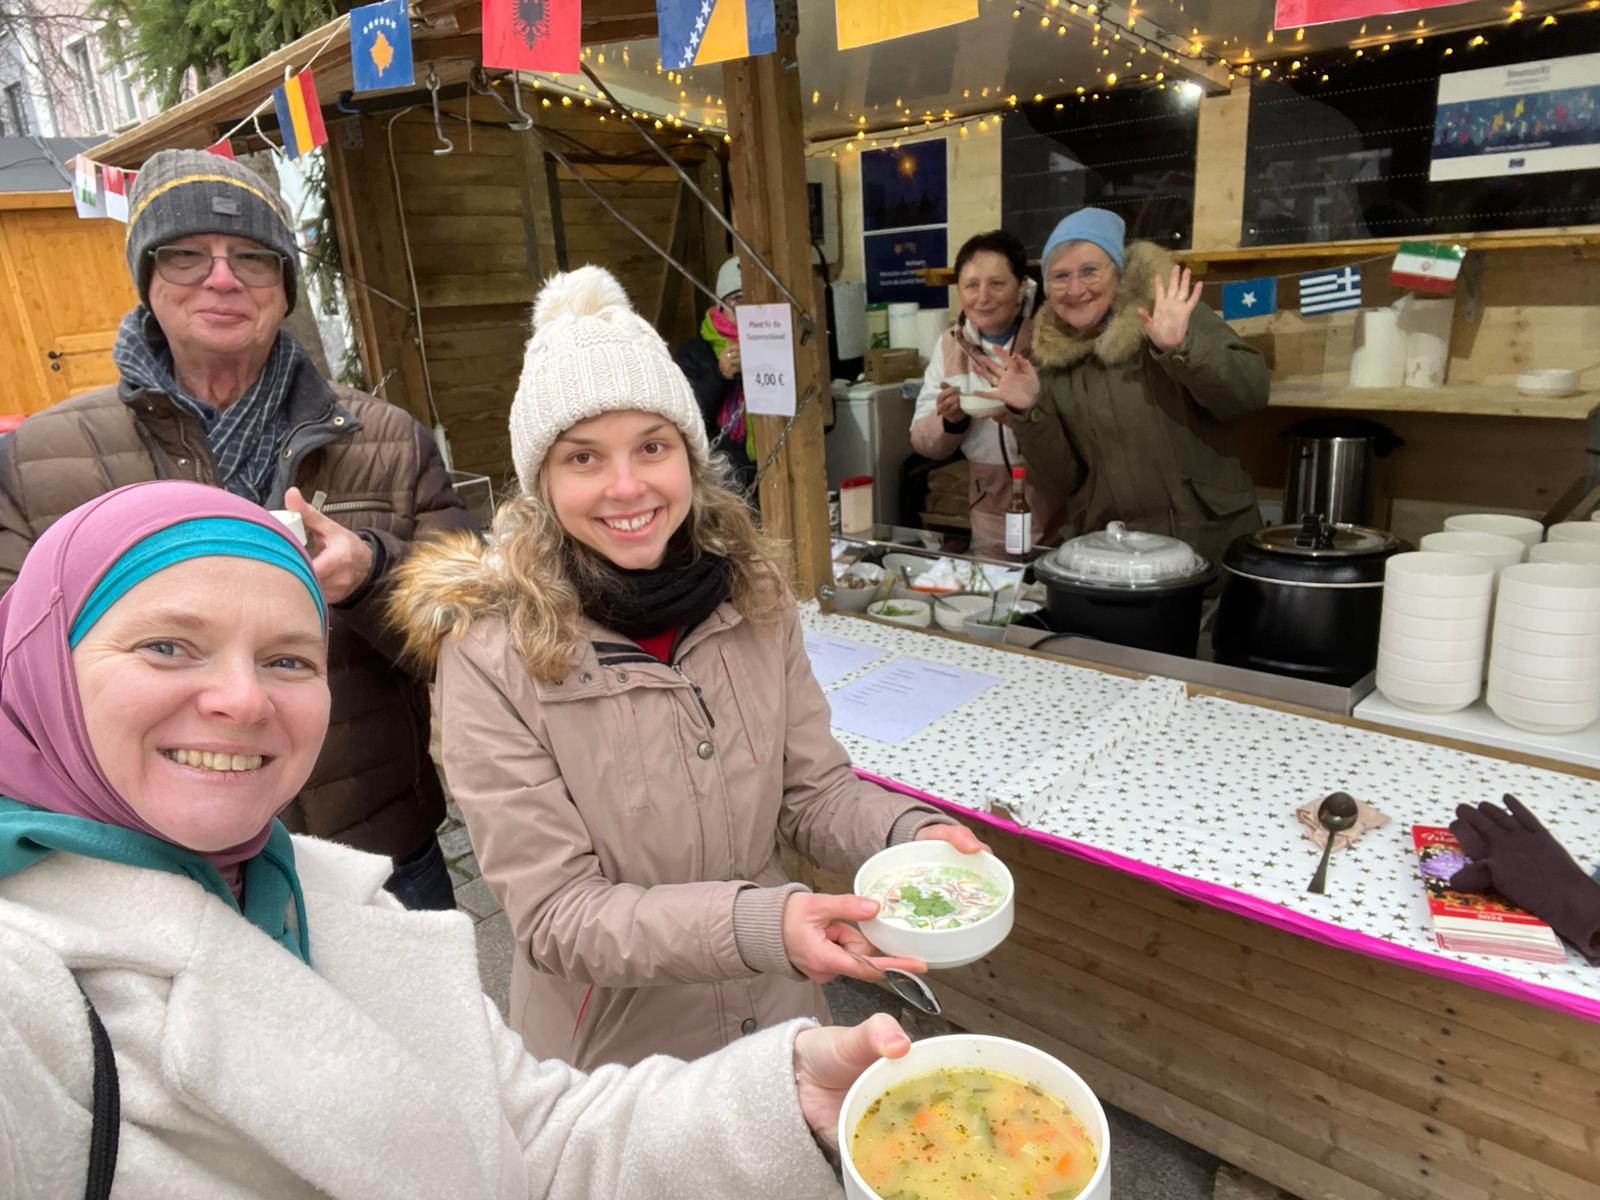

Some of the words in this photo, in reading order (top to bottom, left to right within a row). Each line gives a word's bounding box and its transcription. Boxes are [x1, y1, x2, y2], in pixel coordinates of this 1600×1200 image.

[773, 320, 781, 328] die
[756, 373, 776, 387] 4,00
[778, 373, 784, 386] €
